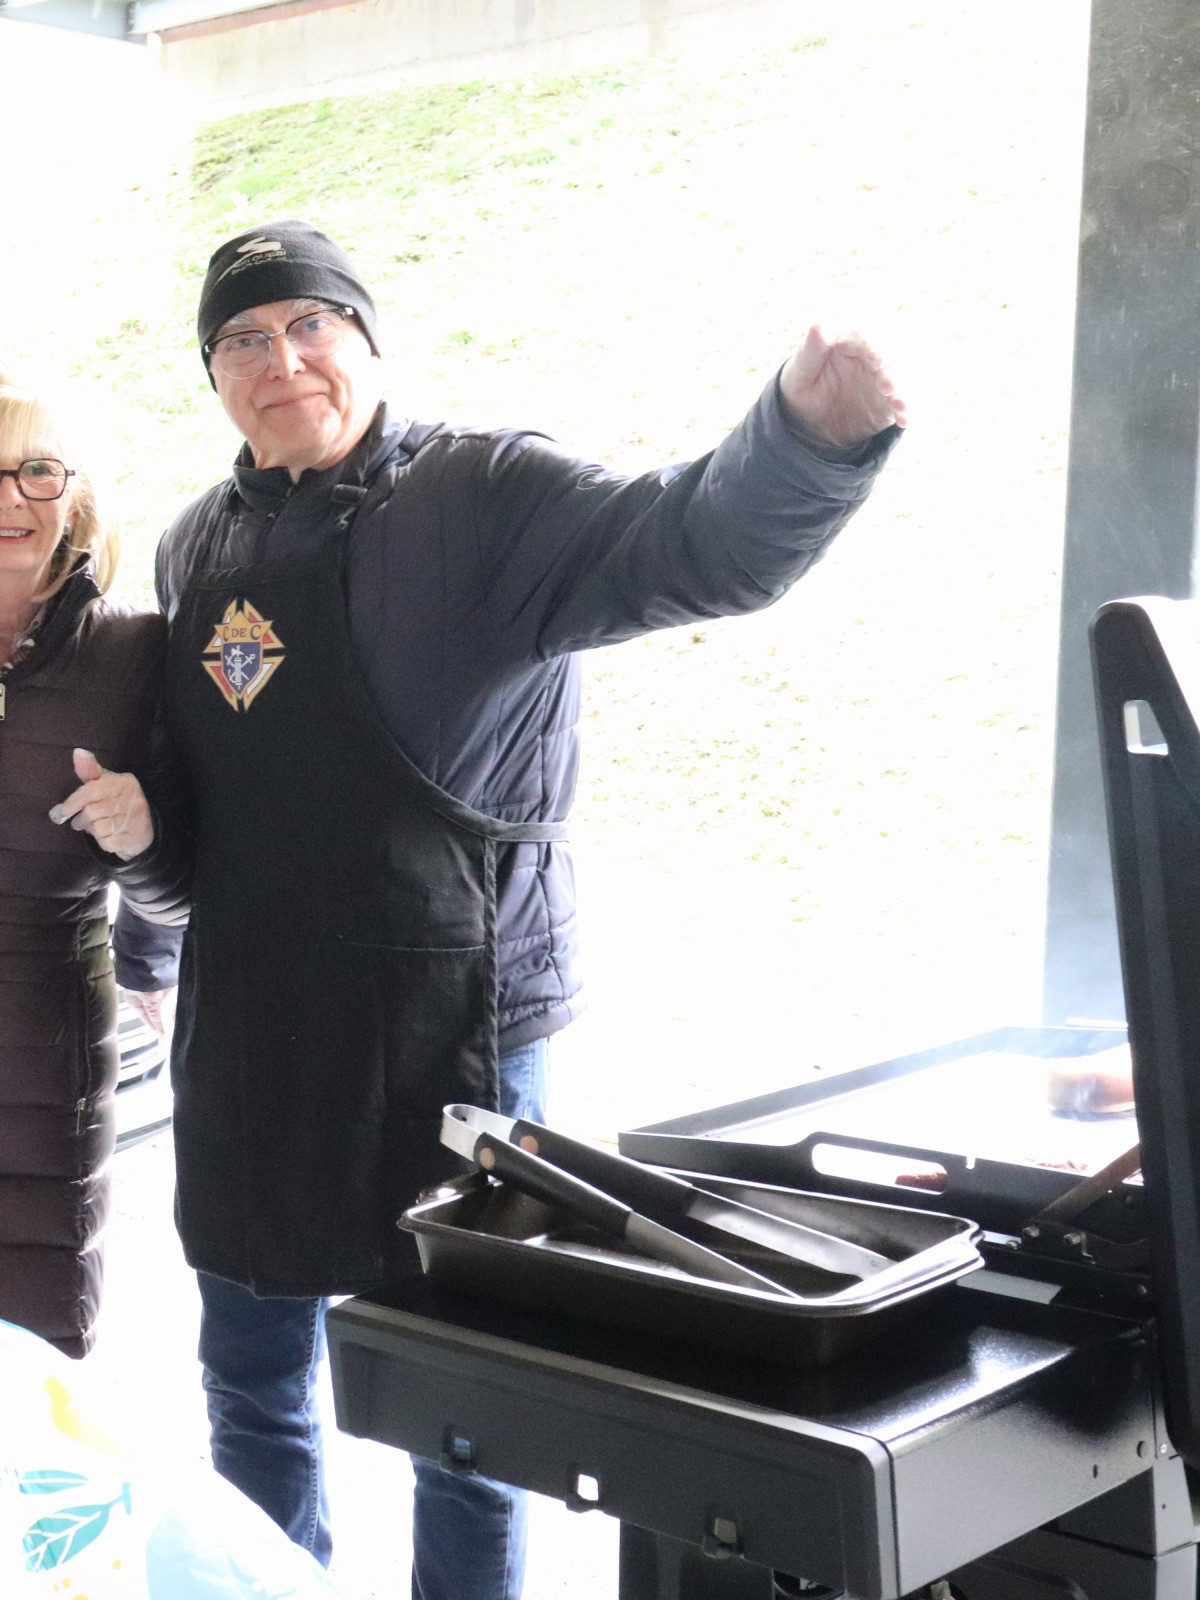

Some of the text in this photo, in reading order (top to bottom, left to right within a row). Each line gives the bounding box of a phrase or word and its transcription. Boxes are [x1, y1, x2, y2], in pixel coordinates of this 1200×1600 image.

[222, 624, 262, 642] C DE C
